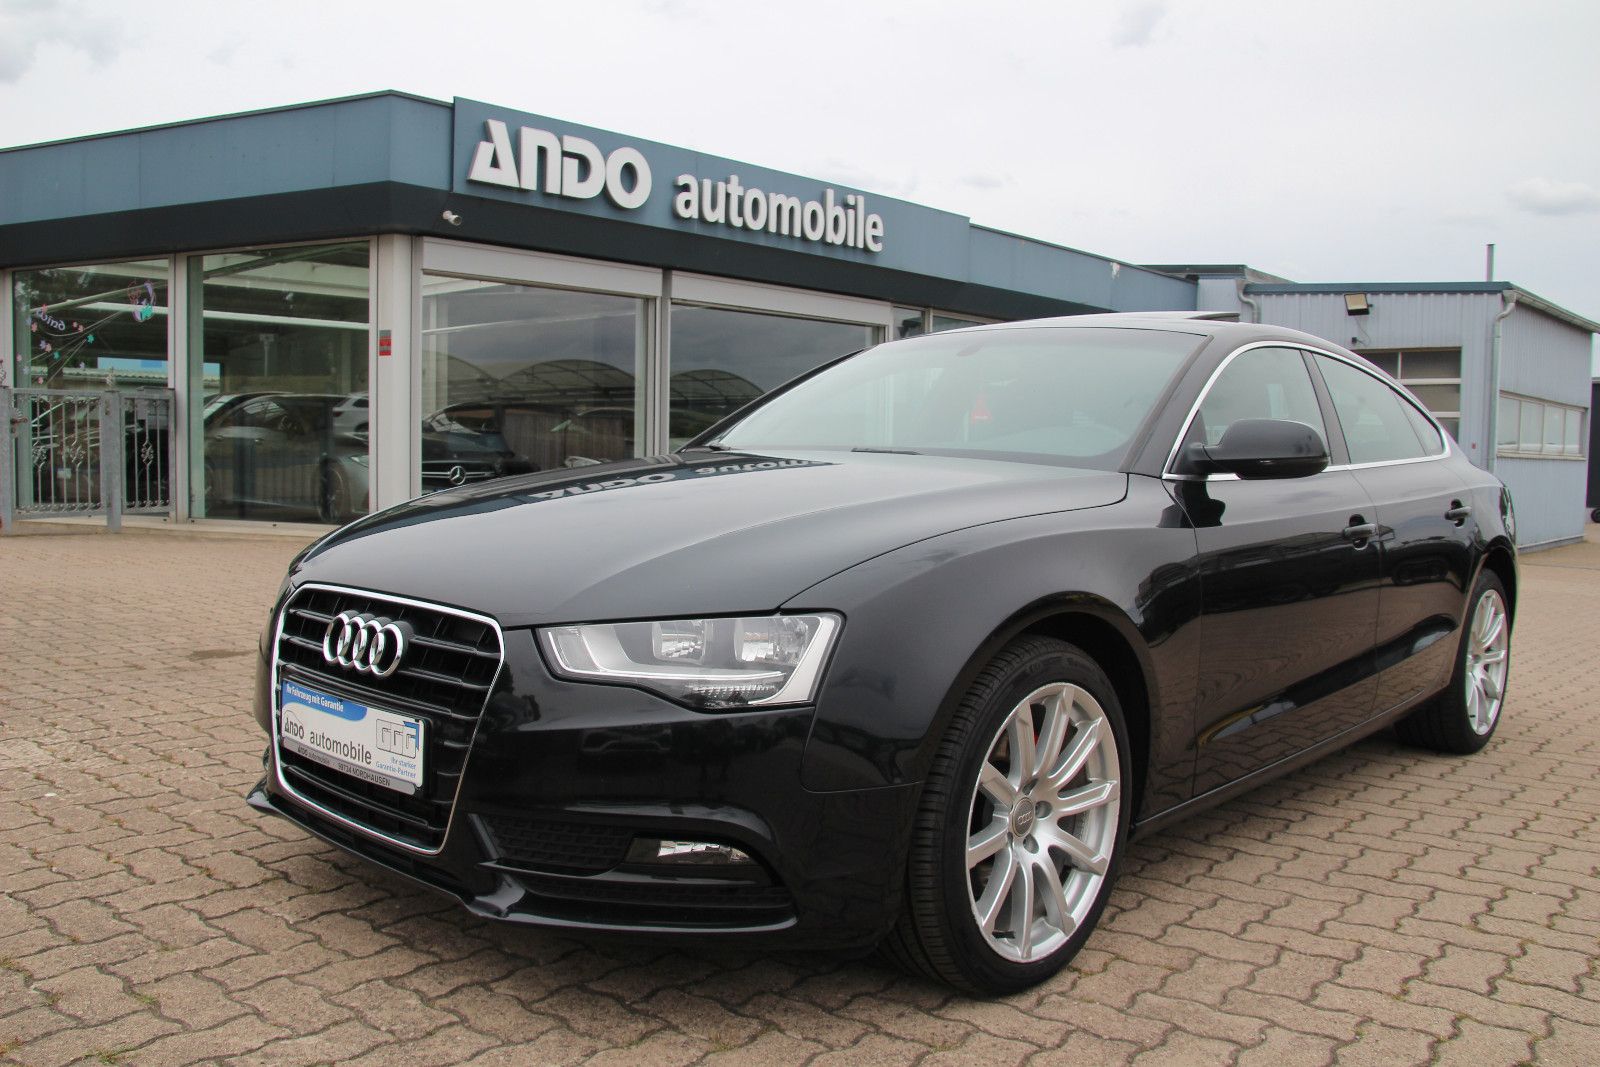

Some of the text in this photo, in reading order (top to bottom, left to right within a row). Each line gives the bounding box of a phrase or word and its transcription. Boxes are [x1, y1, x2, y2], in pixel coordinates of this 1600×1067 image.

[467, 119, 884, 253] ANDO automobile
[320, 697, 344, 712] Garantie
[284, 717, 372, 765] ANDO automobile
[352, 767, 391, 786] NORDHAUSEN
